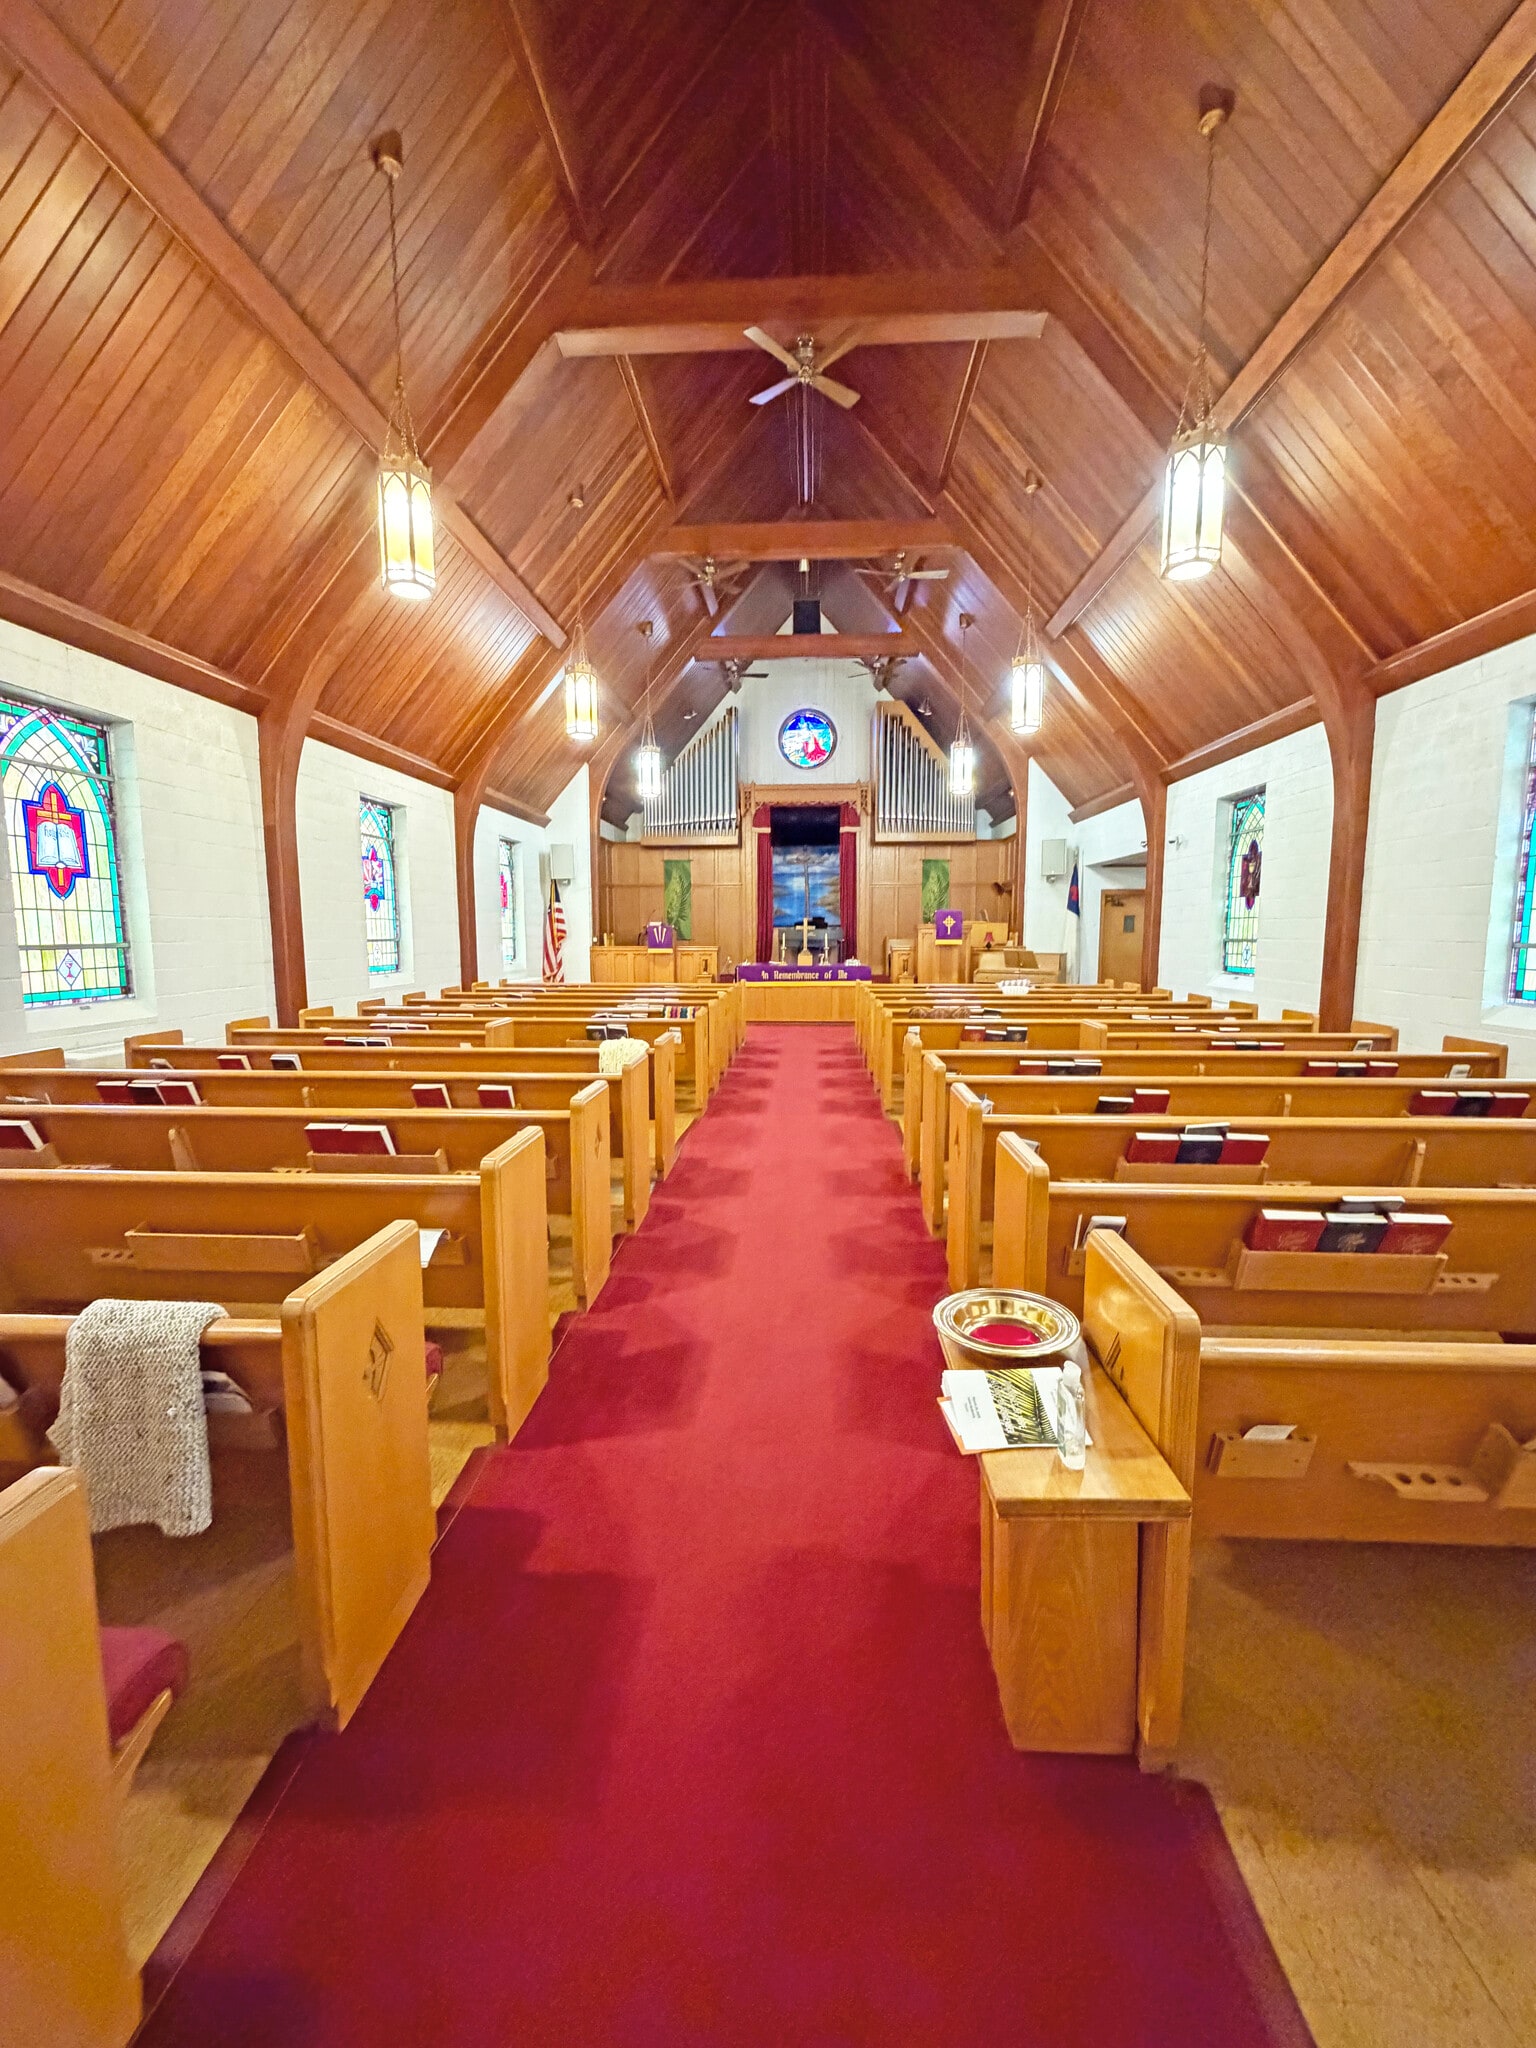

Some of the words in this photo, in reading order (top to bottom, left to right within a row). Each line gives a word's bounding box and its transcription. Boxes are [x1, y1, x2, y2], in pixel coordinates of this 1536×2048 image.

[761, 970, 769, 980] In
[773, 970, 820, 980] Remembrance
[823, 970, 833, 980] of
[838, 969, 848, 980] Me
